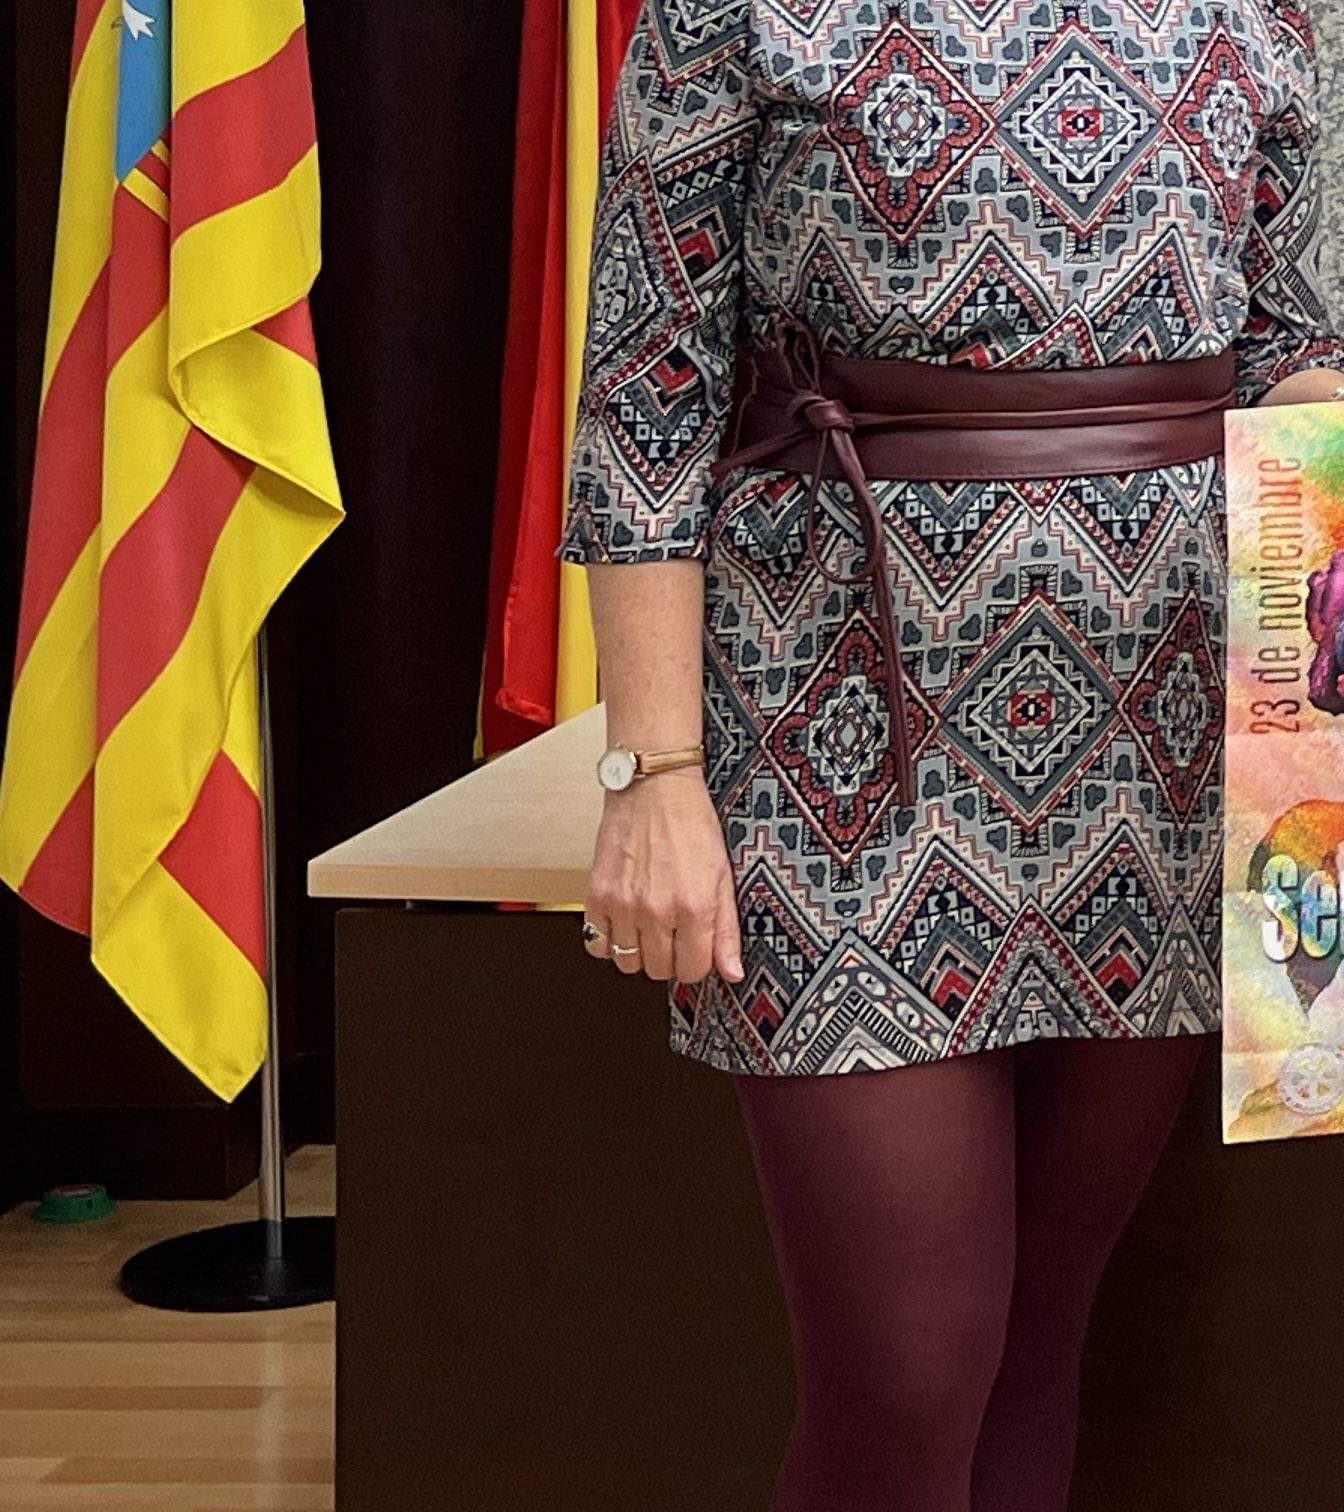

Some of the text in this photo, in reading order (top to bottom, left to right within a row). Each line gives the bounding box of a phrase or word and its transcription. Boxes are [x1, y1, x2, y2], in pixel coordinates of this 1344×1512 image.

[1250, 456, 1303, 735] 23 de noviembre
